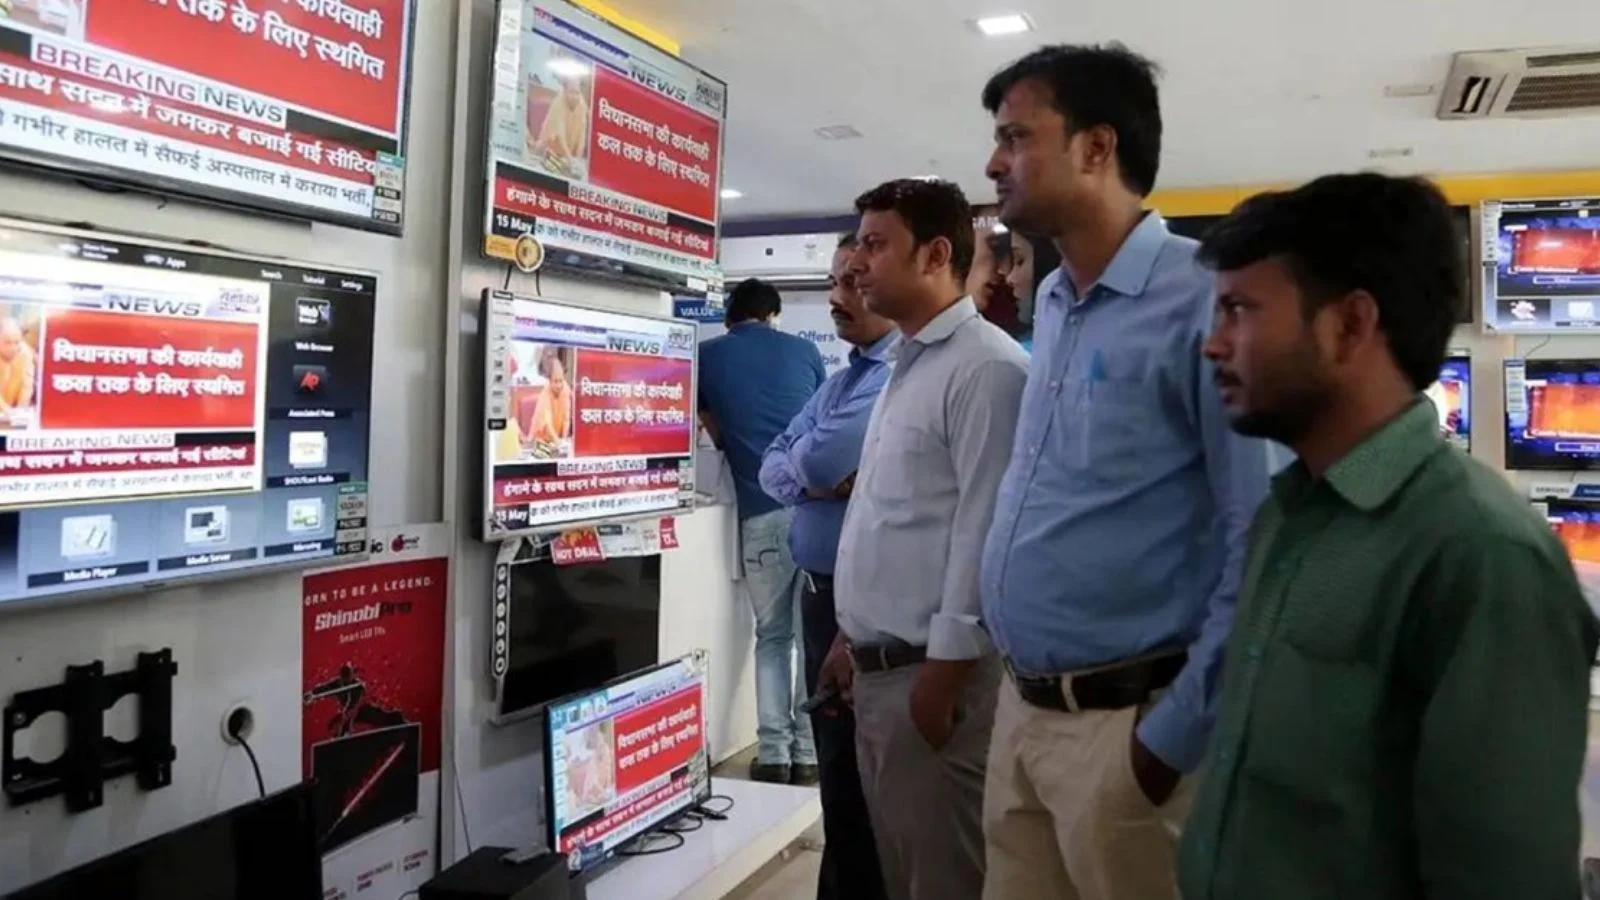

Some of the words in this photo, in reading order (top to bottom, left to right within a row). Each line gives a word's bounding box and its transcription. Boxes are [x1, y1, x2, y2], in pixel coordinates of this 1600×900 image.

[230, 2, 258, 33] के
[263, 11, 311, 59] लिए
[314, 35, 385, 80] स्थगित
[36, 42, 197, 102] BREAKING
[203, 86, 284, 123] NEWS
[630, 63, 688, 102] NEWS
[130, 92, 153, 120] में
[155, 105, 232, 140] जमकर
[236, 126, 293, 158] बजाई
[296, 138, 325, 165] गई
[326, 147, 377, 177] सीटिय
[599, 97, 654, 139] विधानसभा
[655, 124, 670, 145] की
[671, 134, 710, 161] कार्यवाही
[73, 128, 129, 152] हालत
[134, 137, 149, 157] में
[154, 143, 202, 172] सैफई
[206, 158, 275, 186] अस्पताल
[294, 178, 338, 200] कराया
[597, 132, 621, 156] कल
[623, 142, 643, 162] तक
[644, 146, 656, 167] के
[658, 150, 678, 178] लिए
[679, 164, 710, 188] स्थगित
[507, 186, 537, 207] हंगामे
[538, 192, 551, 209] के
[570, 184, 632, 213] BREAKING
[632, 203, 667, 222] NEWS
[497, 214, 510, 228] 15
[511, 217, 532, 236] May
[108, 294, 201, 317] NEWS
[608, 336, 661, 355] NEWS
[798, 330, 835, 342] Offers
[53, 338, 149, 366] विधानसभा
[150, 344, 176, 367] की
[177, 347, 244, 370] कार्यवाही
[52, 374, 93, 394] कल
[95, 376, 131, 395] तक
[132, 371, 152, 396] के
[154, 372, 190, 398] लिए
[191, 375, 246, 397] स्थगित
[581, 376, 632, 398] विधानसभा
[633, 380, 647, 398] की
[647, 381, 684, 401] कार्यवाही
[580, 408, 602, 424] कल
[603, 409, 622, 424] तक
[623, 404, 635, 423] के
[635, 404, 655, 426] लिए
[657, 406, 684, 424] स्थगित
[10, 436, 112, 450] BREAKING
[117, 432, 173, 446] NEWS
[559, 462, 614, 474] BREAKING
[615, 459, 645, 470] NEWS
[504, 480, 530, 497] हंगामे
[531, 479, 542, 494] के
[508, 509, 528, 522] May
[556, 549, 573, 560] HOT
[574, 547, 600, 558] DEAL
[333, 587, 347, 601] TO
[352, 585, 366, 597] BE
[371, 583, 379, 594] A
[339, 632, 360, 644] Smart
[360, 628, 373, 640] LED
